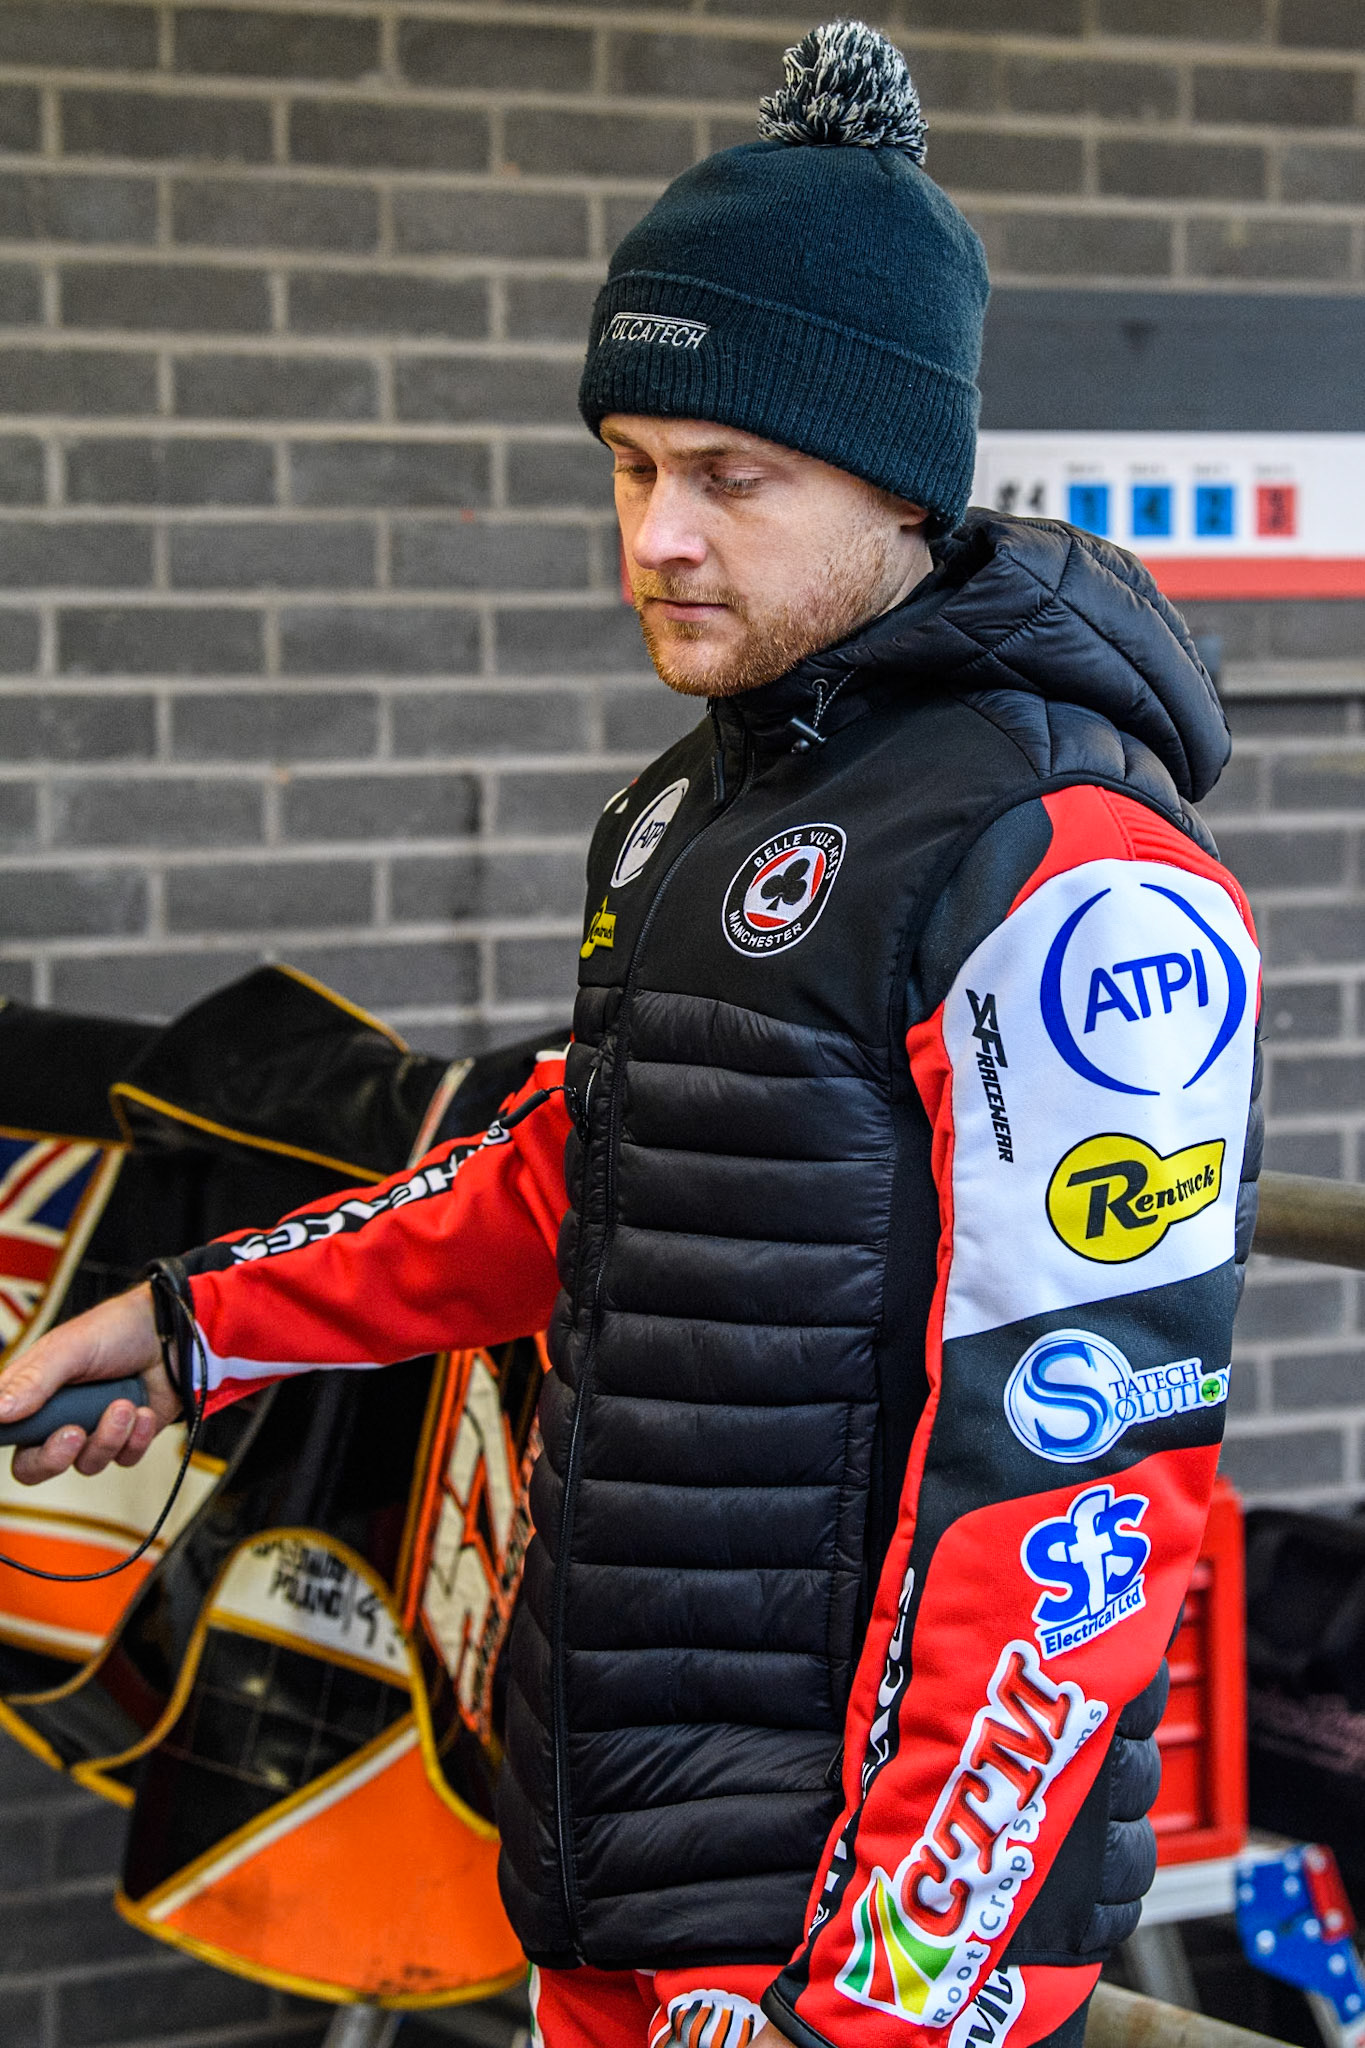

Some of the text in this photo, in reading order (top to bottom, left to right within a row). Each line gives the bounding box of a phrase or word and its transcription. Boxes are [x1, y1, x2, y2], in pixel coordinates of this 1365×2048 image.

[754, 833, 802, 868] BELLE
[810, 830, 836, 848] VUE
[728, 909, 803, 948] MANCHESTER
[1083, 947, 1210, 1034] ATPI
[975, 1050, 1014, 1164] RACEWEAR
[1066, 1159, 1216, 1241] Rentruck
[1044, 1585, 1142, 1655] Electrical Ltd
[901, 1651, 1072, 1938] CTM
[932, 1949, 984, 2025] Root
[979, 1855, 1027, 1932] Crop
